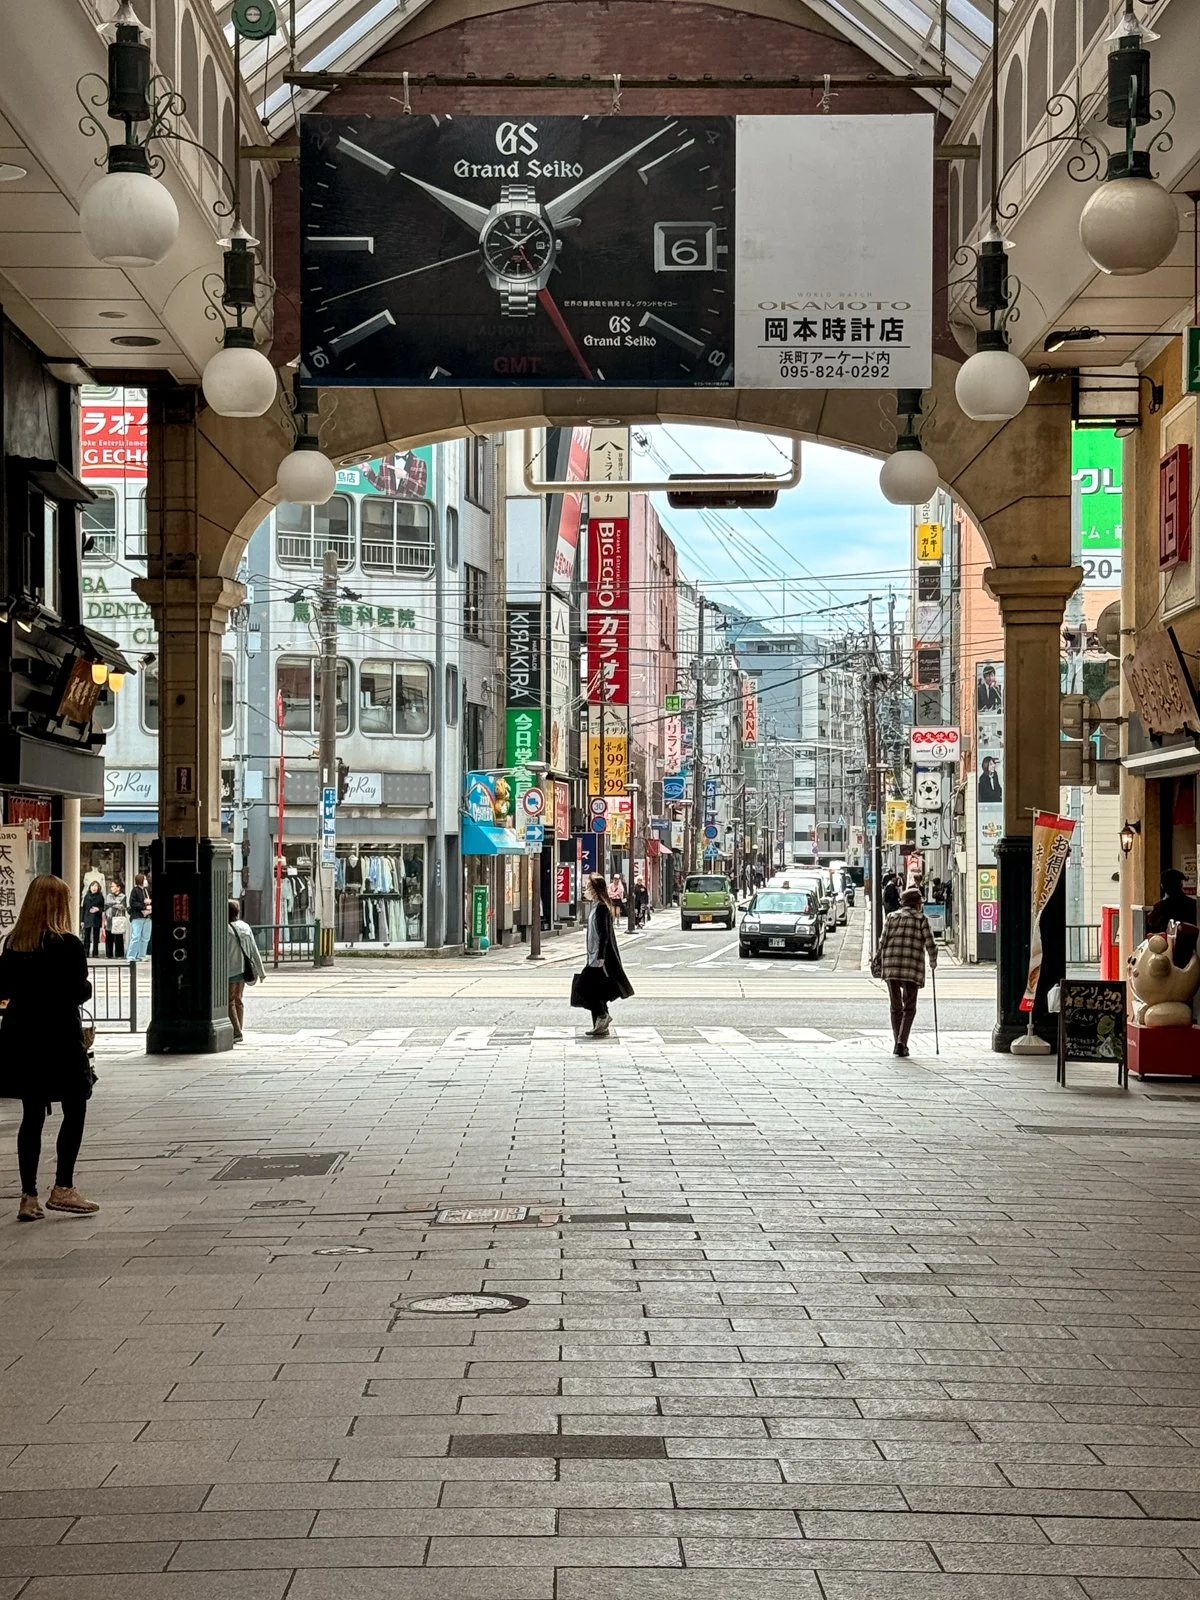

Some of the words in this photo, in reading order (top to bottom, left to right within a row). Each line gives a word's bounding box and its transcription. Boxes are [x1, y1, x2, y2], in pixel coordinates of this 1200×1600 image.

[496, 121, 539, 156] GS
[453, 158, 520, 178] Grand
[526, 158, 584, 178] Seiko
[670, 239, 699, 264] 6
[757, 301, 911, 311] OKAMOTO
[608, 315, 631, 334] GS
[764, 317, 904, 342] 岡本時計店
[583, 334, 621, 347] Grand
[624, 334, 657, 347] Seiko
[308, 345, 330, 368] 16
[707, 349, 726, 367] 8
[778, 351, 890, 364] 浜町アーケード内
[780, 365, 890, 378] 095-824-0292
[604, 450, 613, 503] ミライカ
[598, 522, 615, 555] BIG
[921, 537, 930, 558] ガール
[930, 525, 938, 553] モンキー
[82, 577, 109, 593] BA
[598, 558, 615, 607] ECHO
[293, 602, 416, 629] 馬歯科医院
[510, 612, 530, 700] KIRAKIRA
[598, 616, 620, 701] カラオケ
[745, 700, 755, 741] HANA
[594, 742, 624, 752] ハボール
[105, 771, 153, 798] SpRay
[593, 802, 603, 810] 30
[919, 817, 931, 847] 小吉
